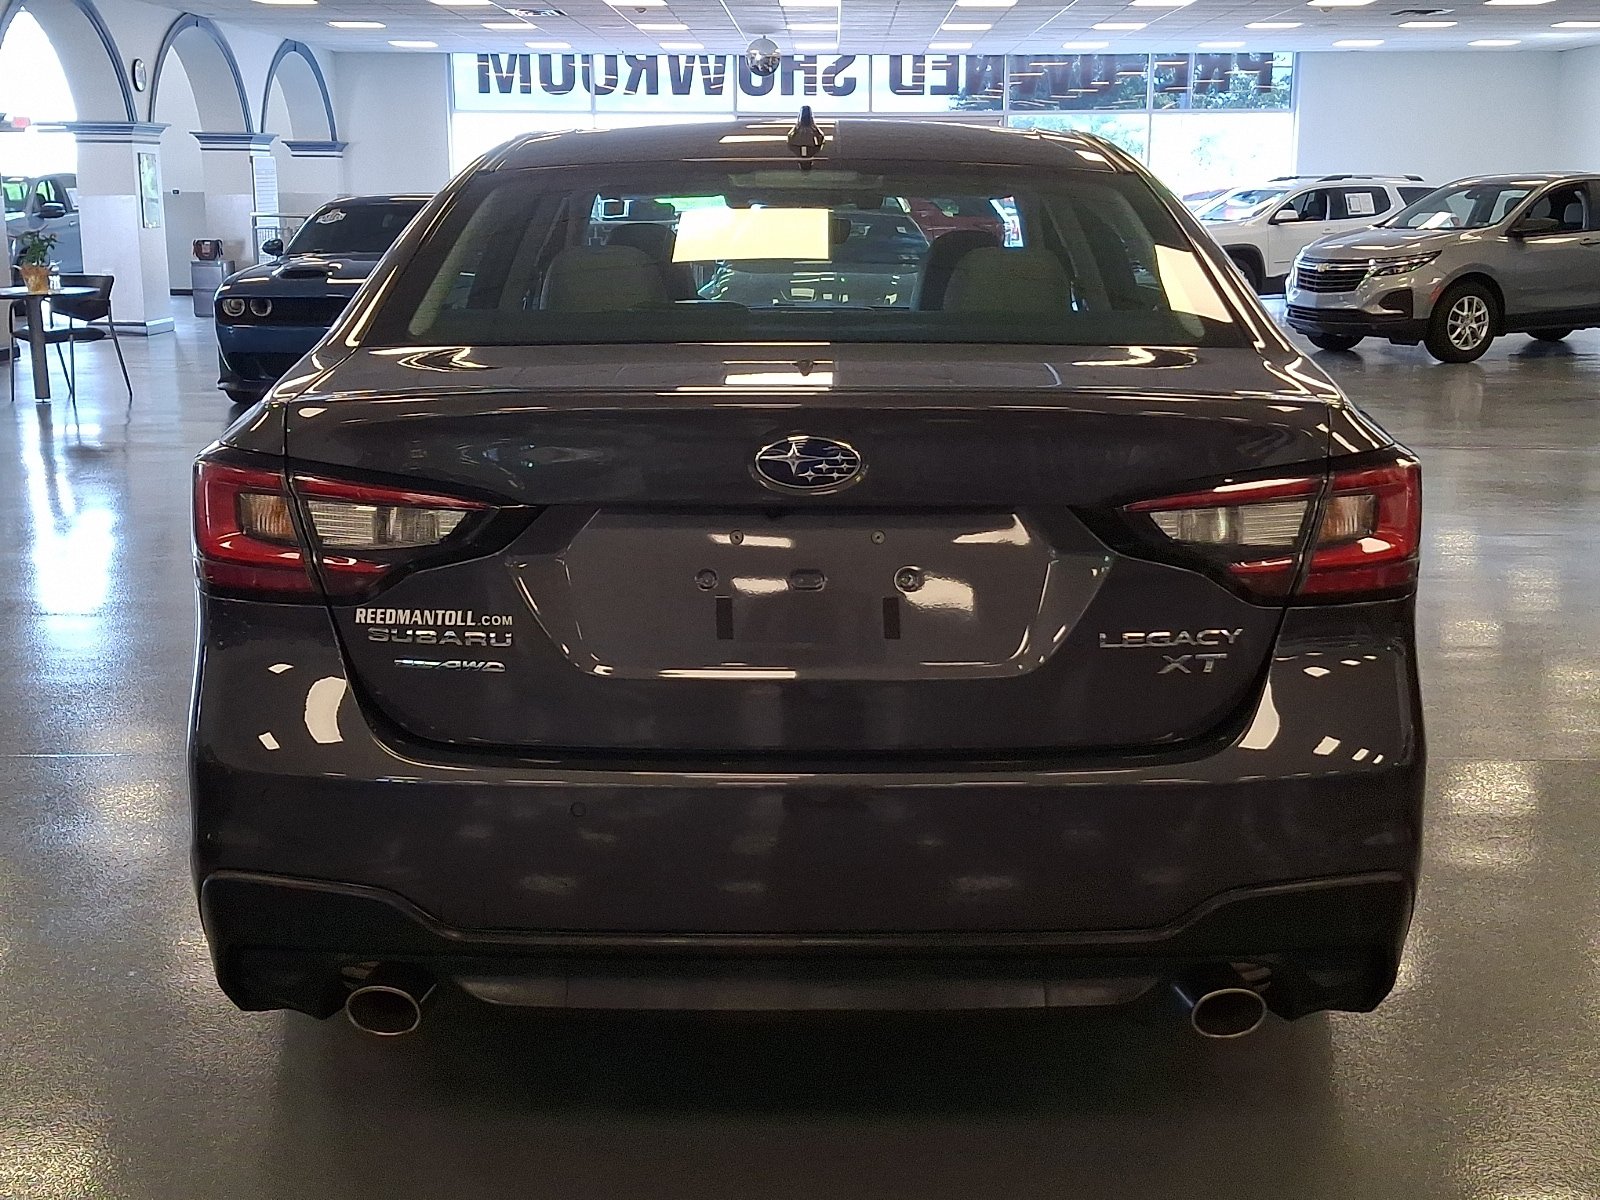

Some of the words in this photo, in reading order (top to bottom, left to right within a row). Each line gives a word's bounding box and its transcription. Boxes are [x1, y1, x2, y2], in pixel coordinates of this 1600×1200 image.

[355, 608, 513, 626] REEDMANTOLL.COM
[368, 627, 512, 647] SUBARU
[1099, 628, 1244, 648] LEGACY
[1157, 653, 1228, 674] XT
